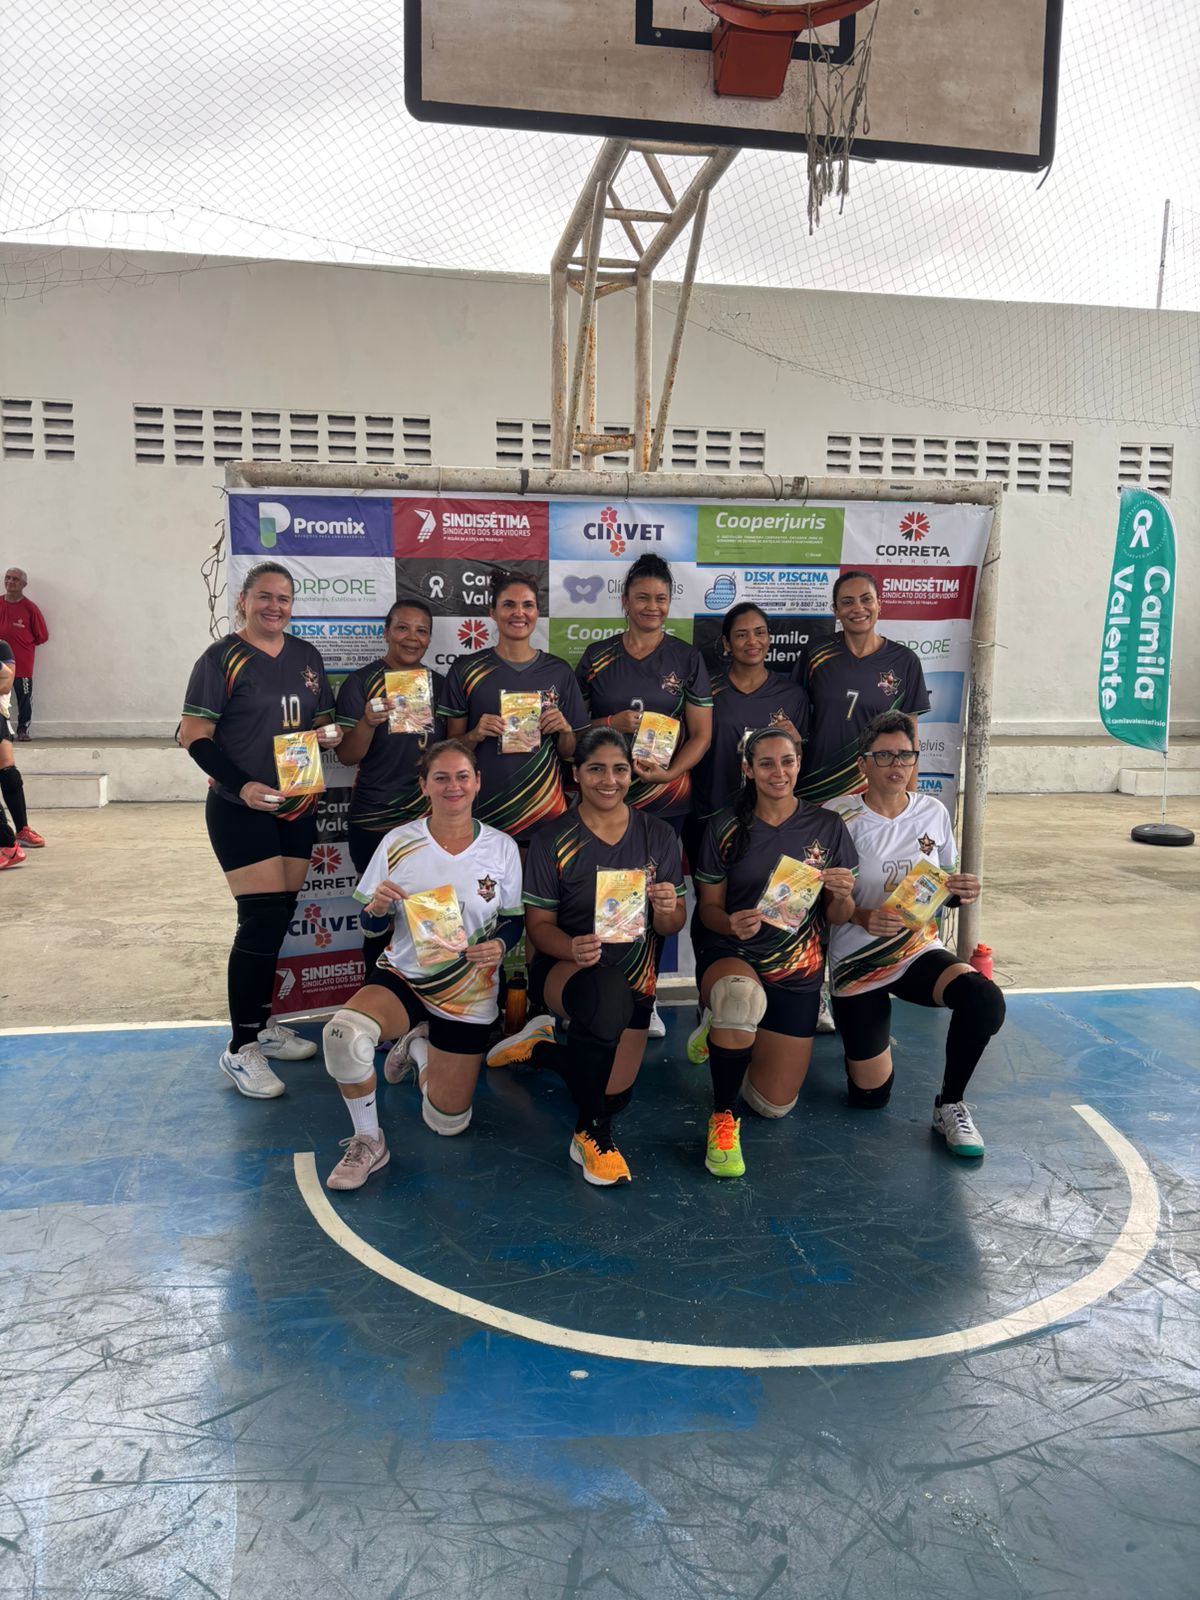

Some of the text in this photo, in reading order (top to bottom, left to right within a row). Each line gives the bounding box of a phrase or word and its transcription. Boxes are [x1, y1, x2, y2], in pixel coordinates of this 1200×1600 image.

[294, 517, 365, 535] Promix
[442, 512, 530, 528] SINDISSÉTIMA
[716, 512, 826, 532] Cooperjuris
[492, 529, 531, 537] SERVIDORES
[583, 523, 664, 540] CINVET
[876, 545, 950, 557] CORRETA
[744, 571, 829, 582] DISK PISCINA
[882, 577, 960, 592] SINDISSÉTIMA
[293, 579, 376, 594] ORPORE
[462, 591, 492, 605] Val
[291, 625, 325, 635] DISK
[769, 630, 809, 644] amila
[1101, 564, 1135, 710] Valente
[1134, 565, 1171, 700] Camila
[846, 689, 860, 719] 7
[281, 696, 300, 729] 10
[317, 800, 351, 814] Cam
[316, 817, 349, 832] Vale
[300, 876, 359, 892] ORRET
[883, 859, 912, 893] 27
[287, 914, 361, 936] CINVE
[301, 960, 366, 981] SINDISSÉTI
[302, 974, 365, 989] SINDICATO DOS SERV
